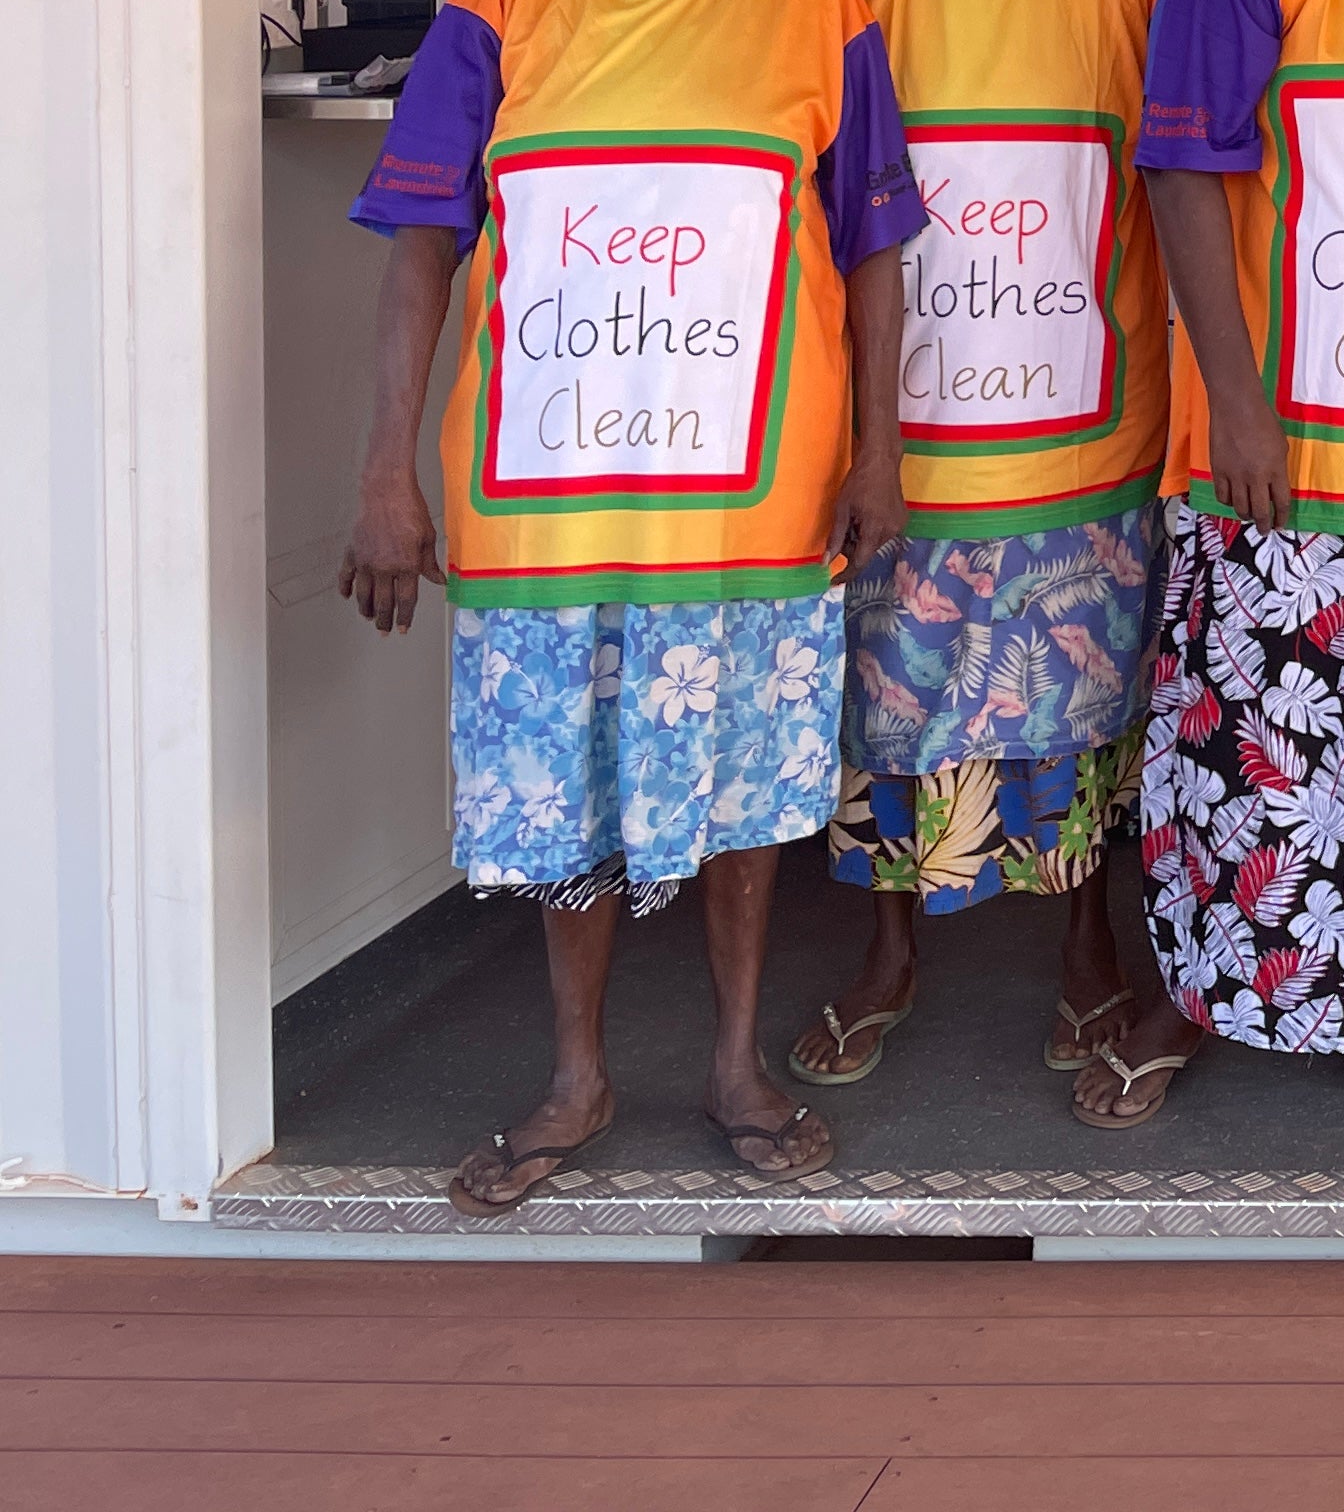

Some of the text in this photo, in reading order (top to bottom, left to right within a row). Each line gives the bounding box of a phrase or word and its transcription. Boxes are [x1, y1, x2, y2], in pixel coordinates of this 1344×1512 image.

[562, 205, 706, 297] Keep
[920, 178, 1049, 265] Keep
[518, 286, 740, 360] Clothes
[902, 336, 1058, 402] Clean
[538, 379, 704, 451] Clean
